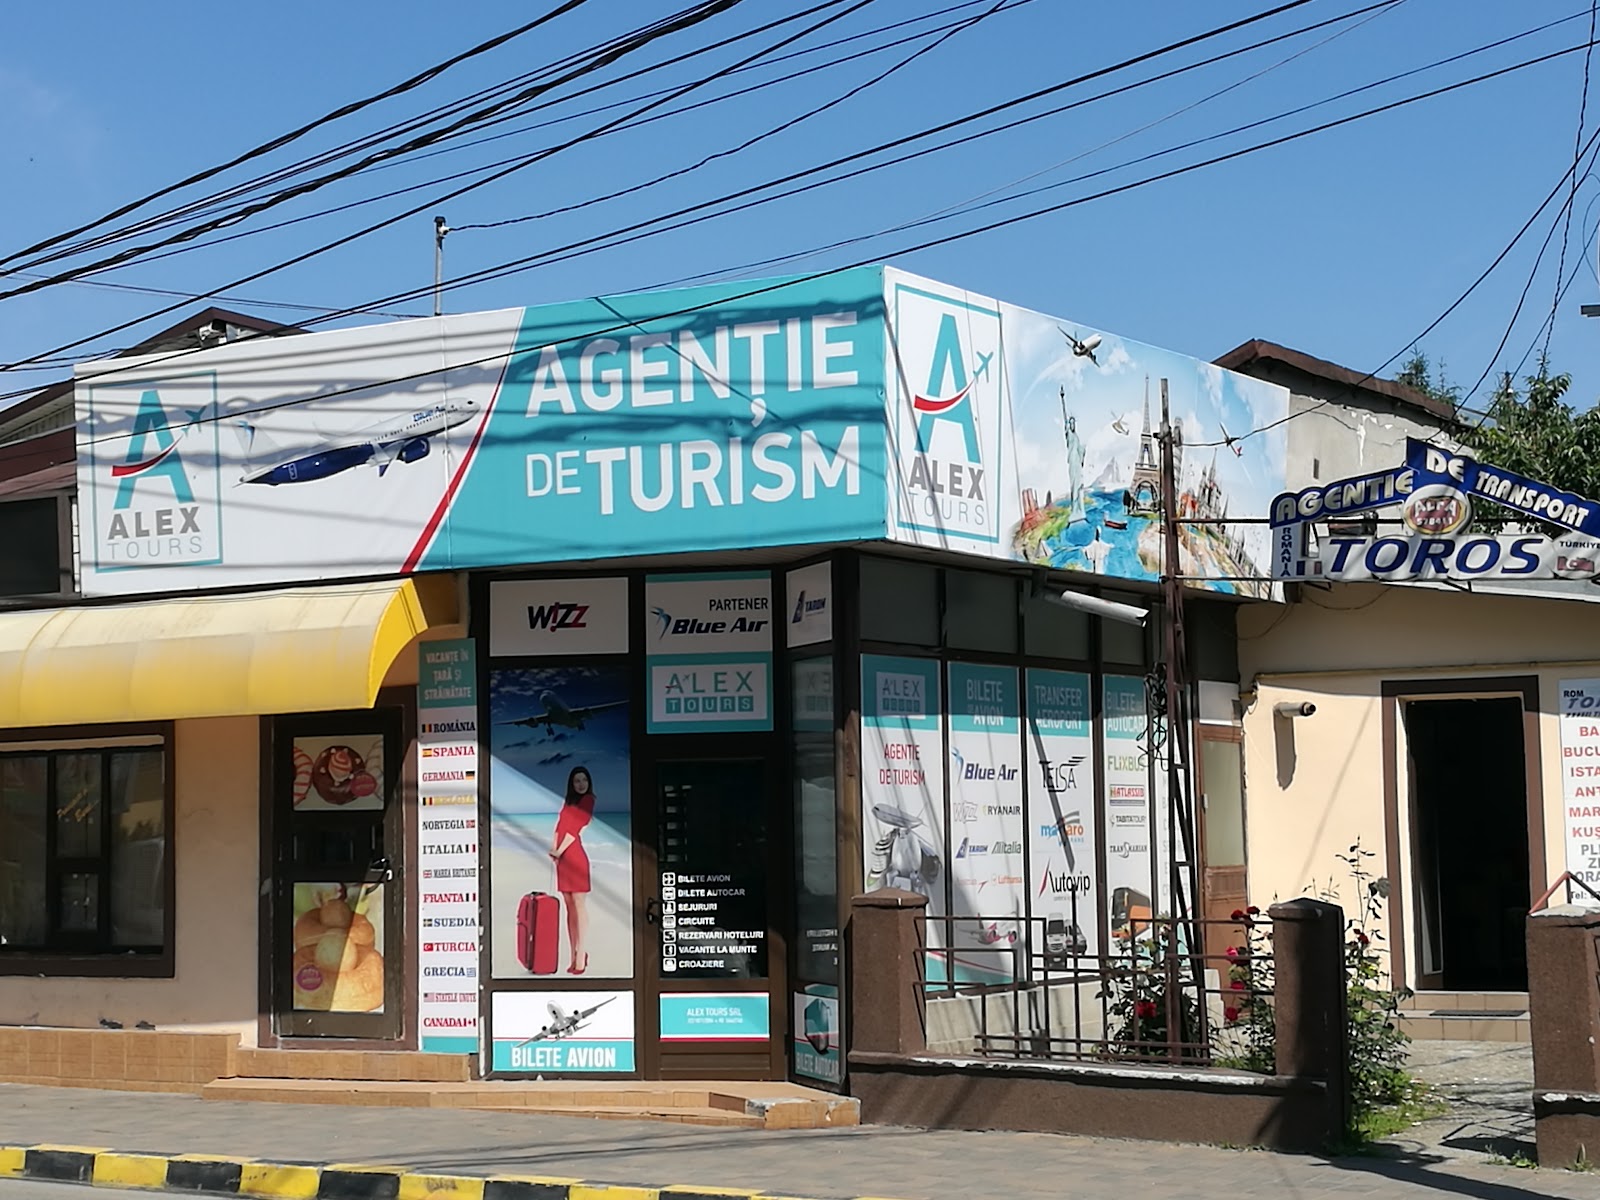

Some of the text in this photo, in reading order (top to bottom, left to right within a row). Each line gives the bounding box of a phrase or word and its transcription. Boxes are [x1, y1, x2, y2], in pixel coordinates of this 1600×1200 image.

[525, 311, 858, 428] AGENȚIE
[526, 426, 860, 516] DE TURISM
[908, 456, 984, 501] ALEX
[1276, 448, 1589, 528] AGENTIE DE TRANSPORT
[908, 491, 984, 525] TOURS
[1415, 499, 1457, 518] ALFA
[107, 507, 200, 540] ALEX
[107, 537, 202, 560] TOURS
[1281, 527, 1292, 577] ROMANIA
[1329, 539, 1544, 574] TOROS
[709, 597, 769, 611] PARTENER
[672, 618, 725, 635] Blue
[665, 671, 753, 694] ALEX
[883, 678, 920, 698] ALEX
[967, 679, 1003, 702] BILETE
[667, 696, 753, 712] TOURS
[1035, 685, 1082, 707] TRANSFER
[1568, 696, 1600, 709] TO
[974, 705, 1004, 726] AVION
[1036, 709, 1082, 730] AEROPORT
[433, 746, 475, 757] SPANIA
[422, 771, 464, 782] GERMANIA
[880, 769, 926, 785] DE TURISM
[964, 763, 995, 780] Blue
[988, 805, 1021, 815] RYANAIR
[422, 820, 465, 830] NORVEGIA
[423, 844, 464, 855] ITALIA
[991, 841, 1022, 855] Alitalia
[1581, 844, 1600, 855] PL
[678, 875, 731, 883] BILETE AVION
[706, 889, 746, 897] AUTOCAR
[678, 903, 718, 911] SEJURURI
[434, 918, 476, 927] SUEDIA
[678, 917, 715, 926] CIRCUITE
[678, 931, 764, 939] REZERVARI HOTELURI
[435, 942, 476, 952] TURCIA
[729, 945, 757, 954] MUNTE
[423, 967, 465, 977] GRECIA
[679, 960, 724, 969] CROAZIERE
[423, 1017, 462, 1027] CANADA
[512, 1047, 616, 1068] BILETE AVION
